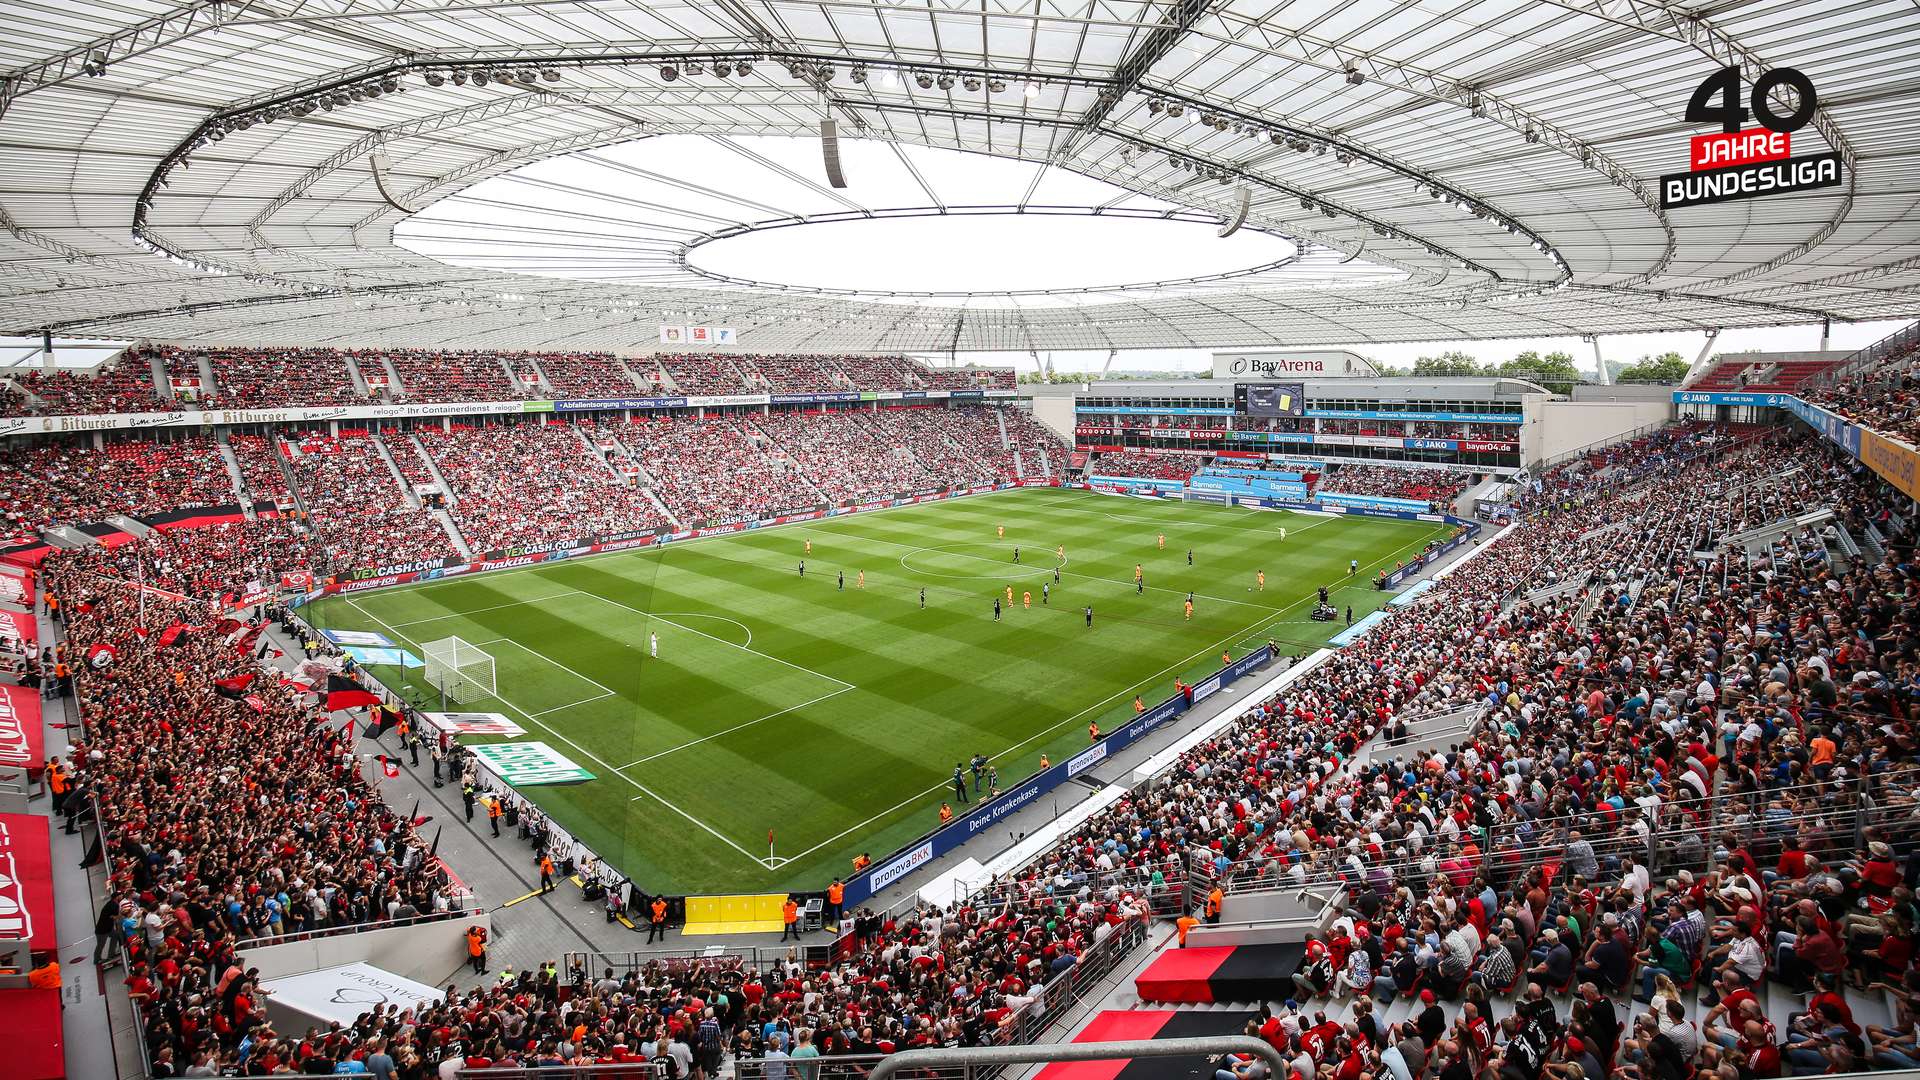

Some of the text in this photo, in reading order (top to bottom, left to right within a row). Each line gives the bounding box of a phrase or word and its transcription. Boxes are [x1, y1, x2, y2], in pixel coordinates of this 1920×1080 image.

[1251, 359, 1323, 374] BayArena
[563, 398, 683, 409] Abfallentsorgung Recycling Logistik
[1690, 394, 1710, 402] JAKO
[373, 405, 490, 416] relogo Ihr Containerdienst
[223, 411, 288, 423] Bitburger
[61, 417, 117, 430] Bitburger
[1240, 432, 1260, 440] Bayer
[1274, 434, 1308, 443] Barmenia
[1425, 441, 1448, 449] JAKO
[1466, 441, 1511, 452] bayer04.de
[1090, 485, 1118, 493] makita
[1192, 480, 1223, 489] Barmenia
[1270, 482, 1304, 492] Barmenia
[854, 493, 895, 506] VEXCASH.COM
[857, 503, 883, 512] makita
[706, 513, 760, 527] VEXCASH.COM
[609, 533, 622, 541] TAGE
[622, 532, 637, 540] GELD
[698, 525, 736, 537] makita
[504, 539, 578, 557] VEXCASH.COM
[352, 558, 444, 580] VEXCASH.COM
[480, 556, 534, 571] makita
[340, 576, 398, 592] LITHIUM-ION
[1246, 653, 1267, 669] Krankenkasse
[1194, 680, 1220, 702] pronovaBKK
[1129, 706, 1175, 738] Deine Krankenkasse
[1069, 745, 1106, 772] pronovaBKK
[969, 785, 1039, 832] Deine Krankenkasse
[874, 847, 930, 889] pronovaBKK
